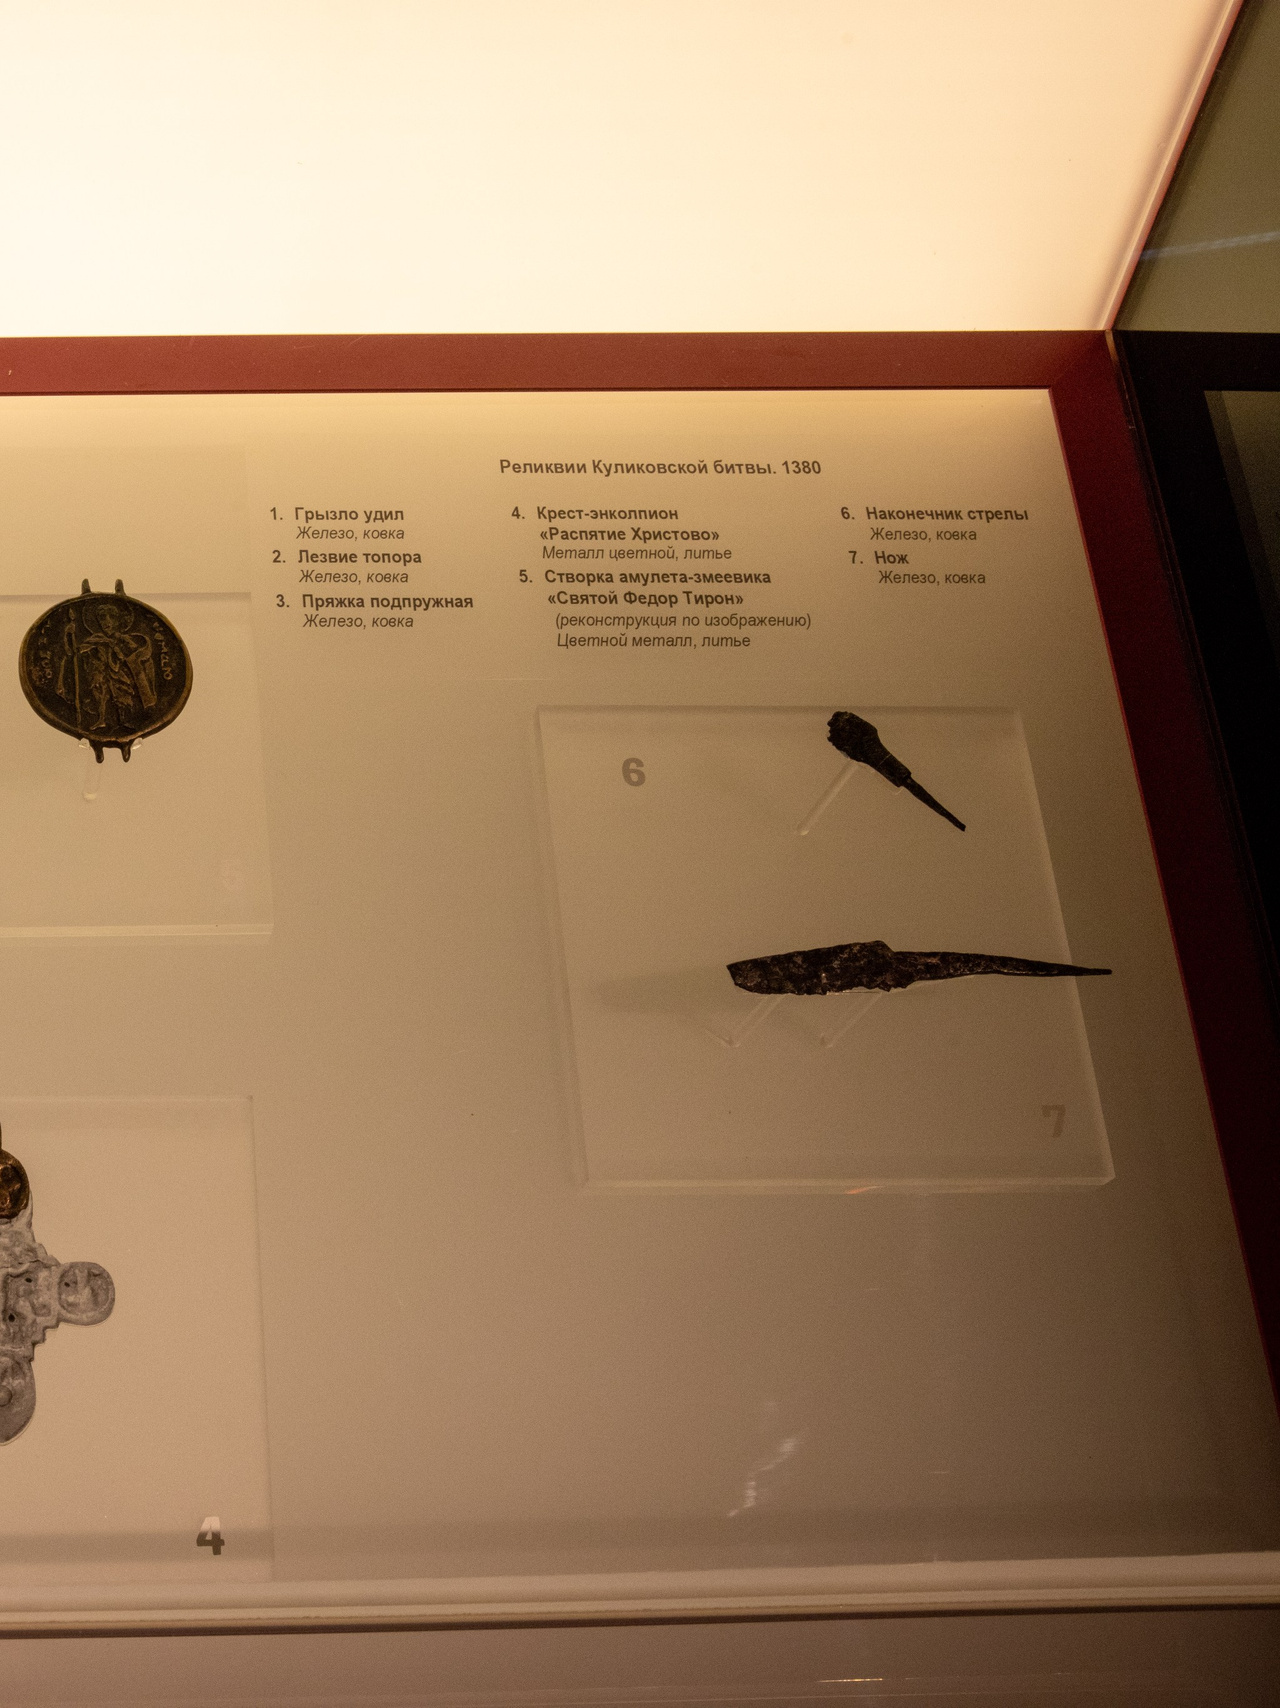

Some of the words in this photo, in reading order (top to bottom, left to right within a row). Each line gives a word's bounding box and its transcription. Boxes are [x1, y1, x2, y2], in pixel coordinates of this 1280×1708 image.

[499, 458, 588, 474] Реликвии
[591, 459, 709, 478] Куликовской
[712, 459, 777, 475] битвы.
[781, 459, 822, 475] 1380
[269, 506, 284, 521] 1.
[294, 506, 359, 524] Грызло
[363, 509, 405, 524] удил
[511, 505, 526, 520] 4.
[536, 505, 679, 523] Крест-энколпион
[840, 506, 855, 521] 6.
[865, 506, 964, 521] Наконечник
[966, 509, 1029, 524] стрелы
[295, 525, 358, 541] Железо,
[362, 528, 405, 540] ковка
[539, 526, 627, 541] «Распятие
[630, 526, 720, 544] Христово»
[869, 526, 932, 543] Железо,
[936, 530, 978, 541] ковка
[272, 549, 288, 564] 2.
[297, 549, 358, 564] Лезвие
[362, 552, 422, 567] топора
[541, 545, 605, 560] Металл
[608, 545, 679, 562] цветной,
[683, 548, 733, 560] литье
[847, 549, 864, 565] 7.
[873, 550, 910, 565] Нож
[298, 568, 362, 585] Железо,
[367, 572, 409, 584] ковка
[518, 568, 533, 584] 5.
[544, 568, 615, 587] Створка
[619, 572, 772, 587] амулета-змеевика
[878, 569, 940, 586] Железо,
[944, 573, 986, 585] ковка
[275, 593, 291, 609] 3.
[301, 593, 365, 612] Пряжка
[370, 596, 474, 612] подпружная
[547, 590, 619, 605] «Святой
[622, 590, 679, 609] Федор
[682, 590, 744, 609] Тирон»
[302, 613, 367, 630] Железо,
[371, 616, 414, 628] ковка
[555, 612, 677, 631] (реконструкция
[681, 615, 701, 627] по
[704, 612, 812, 630] изображению)
[556, 632, 628, 650] Цветной
[631, 635, 697, 649] металл,
[701, 635, 751, 648] литье
[622, 756, 647, 787] 6
[1041, 1104, 1066, 1138] 7
[195, 1515, 226, 1556] 4
